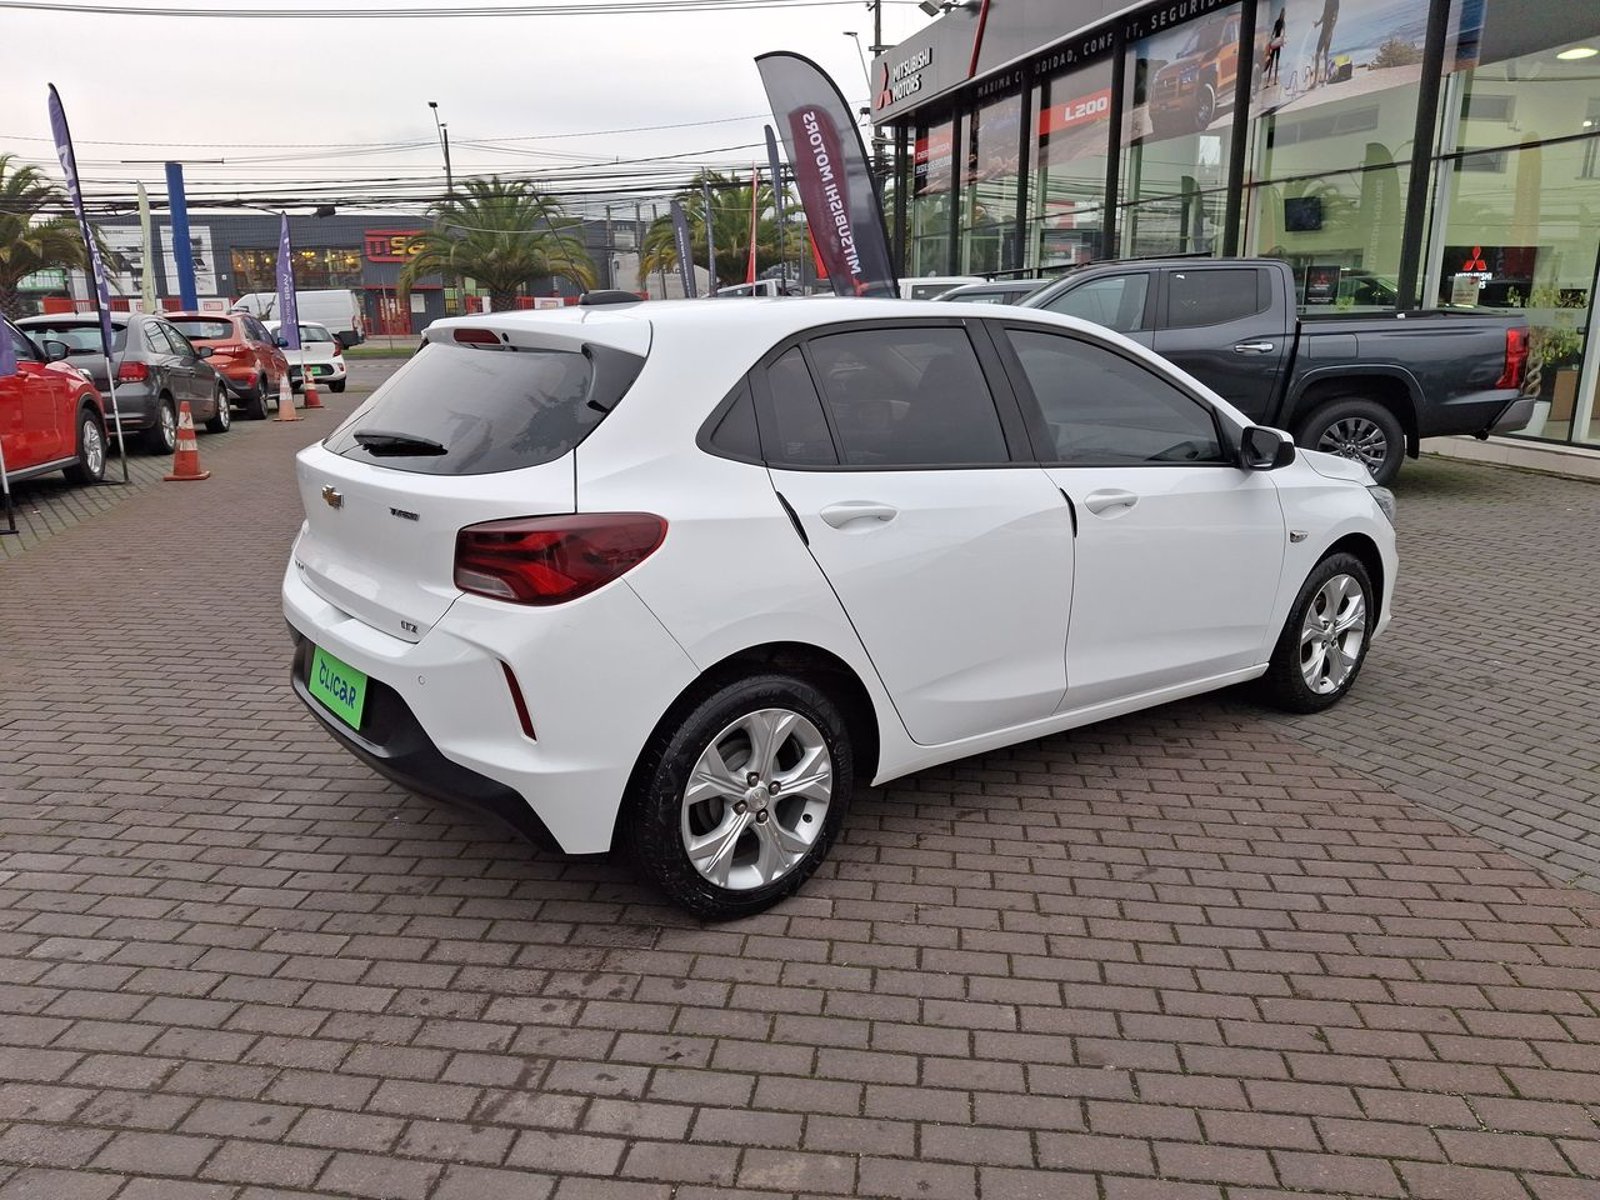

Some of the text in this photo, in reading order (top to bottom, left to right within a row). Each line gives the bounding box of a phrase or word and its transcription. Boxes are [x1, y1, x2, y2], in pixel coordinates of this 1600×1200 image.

[893, 47, 932, 82] MITSUBISHI
[1014, 49, 1077, 83] CODIDAD,
[1083, 21, 1143, 56] CONFT,
[893, 74, 922, 101] MOTORS
[1065, 96, 1108, 121] L200
